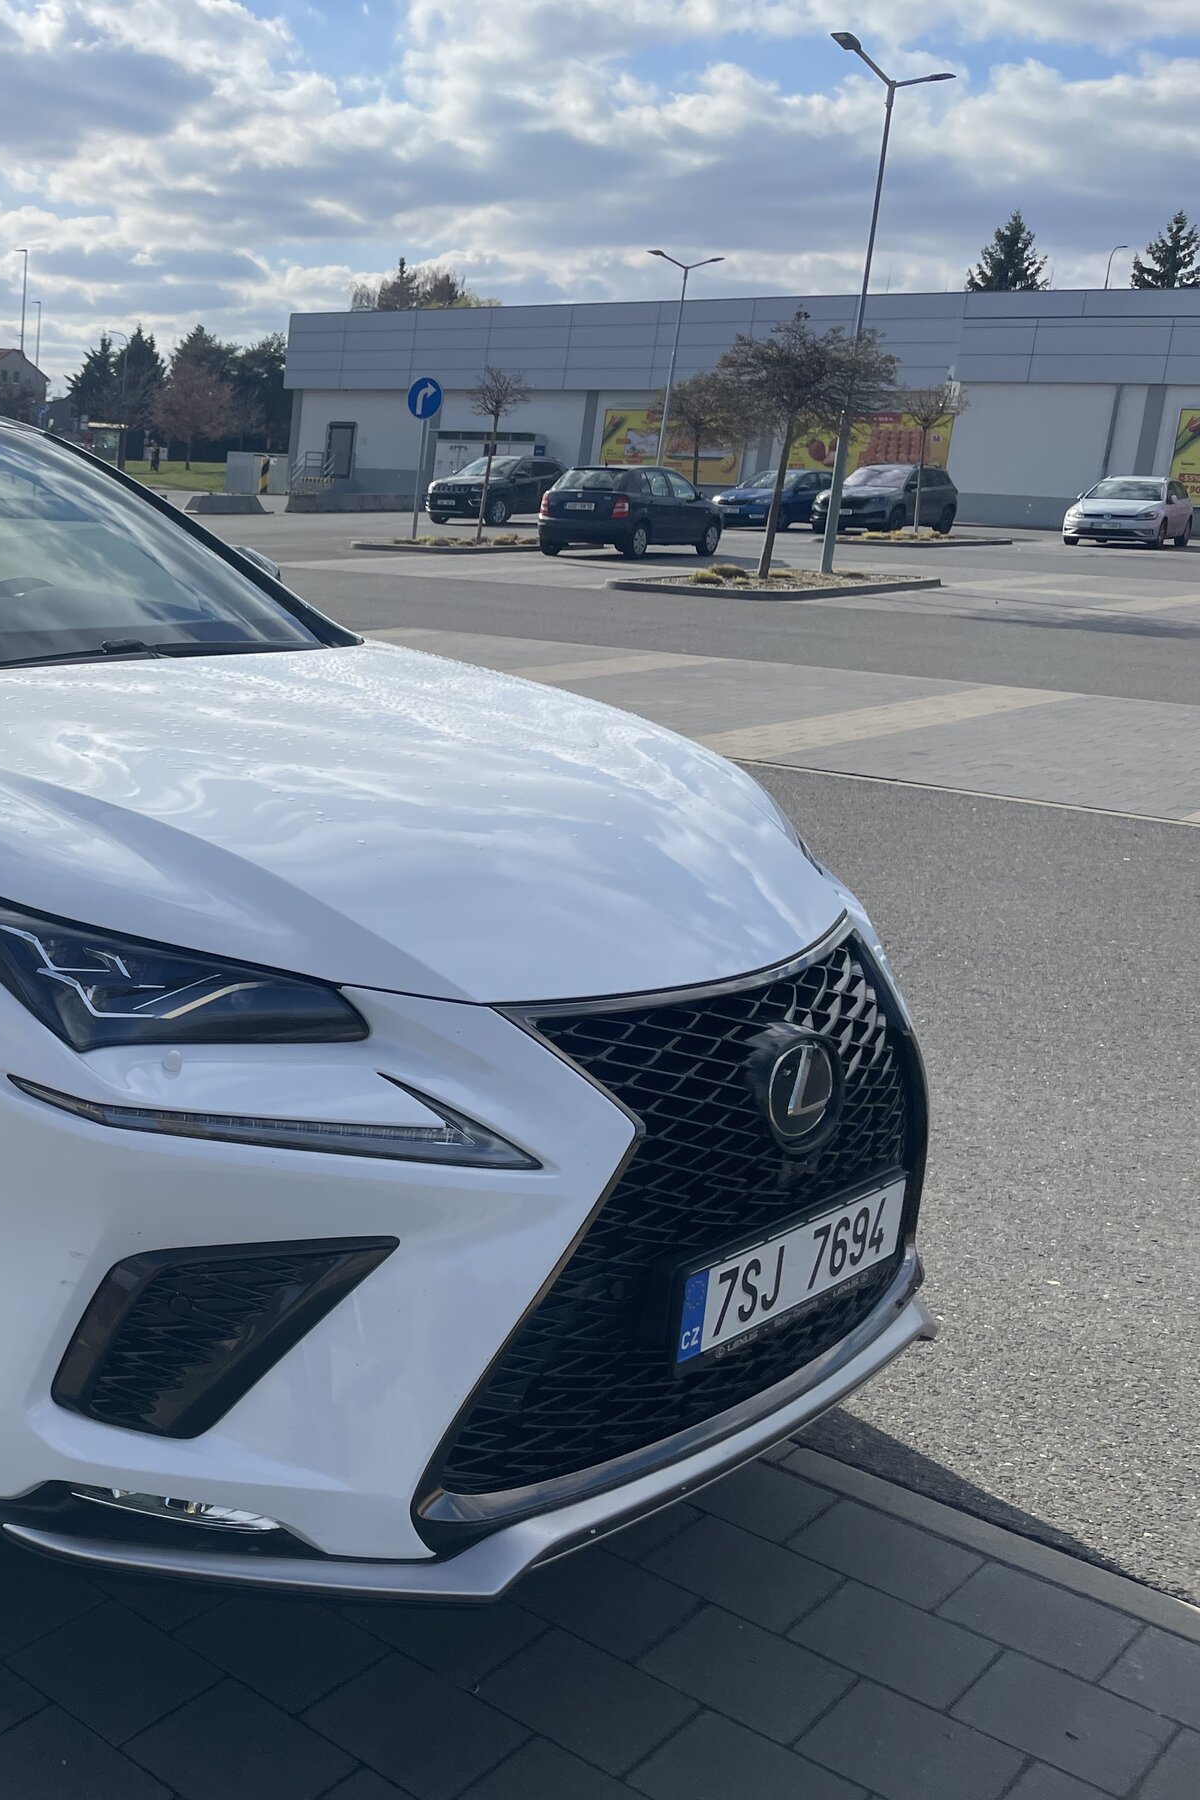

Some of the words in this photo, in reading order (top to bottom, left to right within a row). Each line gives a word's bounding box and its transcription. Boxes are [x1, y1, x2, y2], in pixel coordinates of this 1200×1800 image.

[712, 1245, 785, 1337] 7SJ
[807, 1197, 887, 1291] 7694
[681, 1326, 700, 1350] CZ
